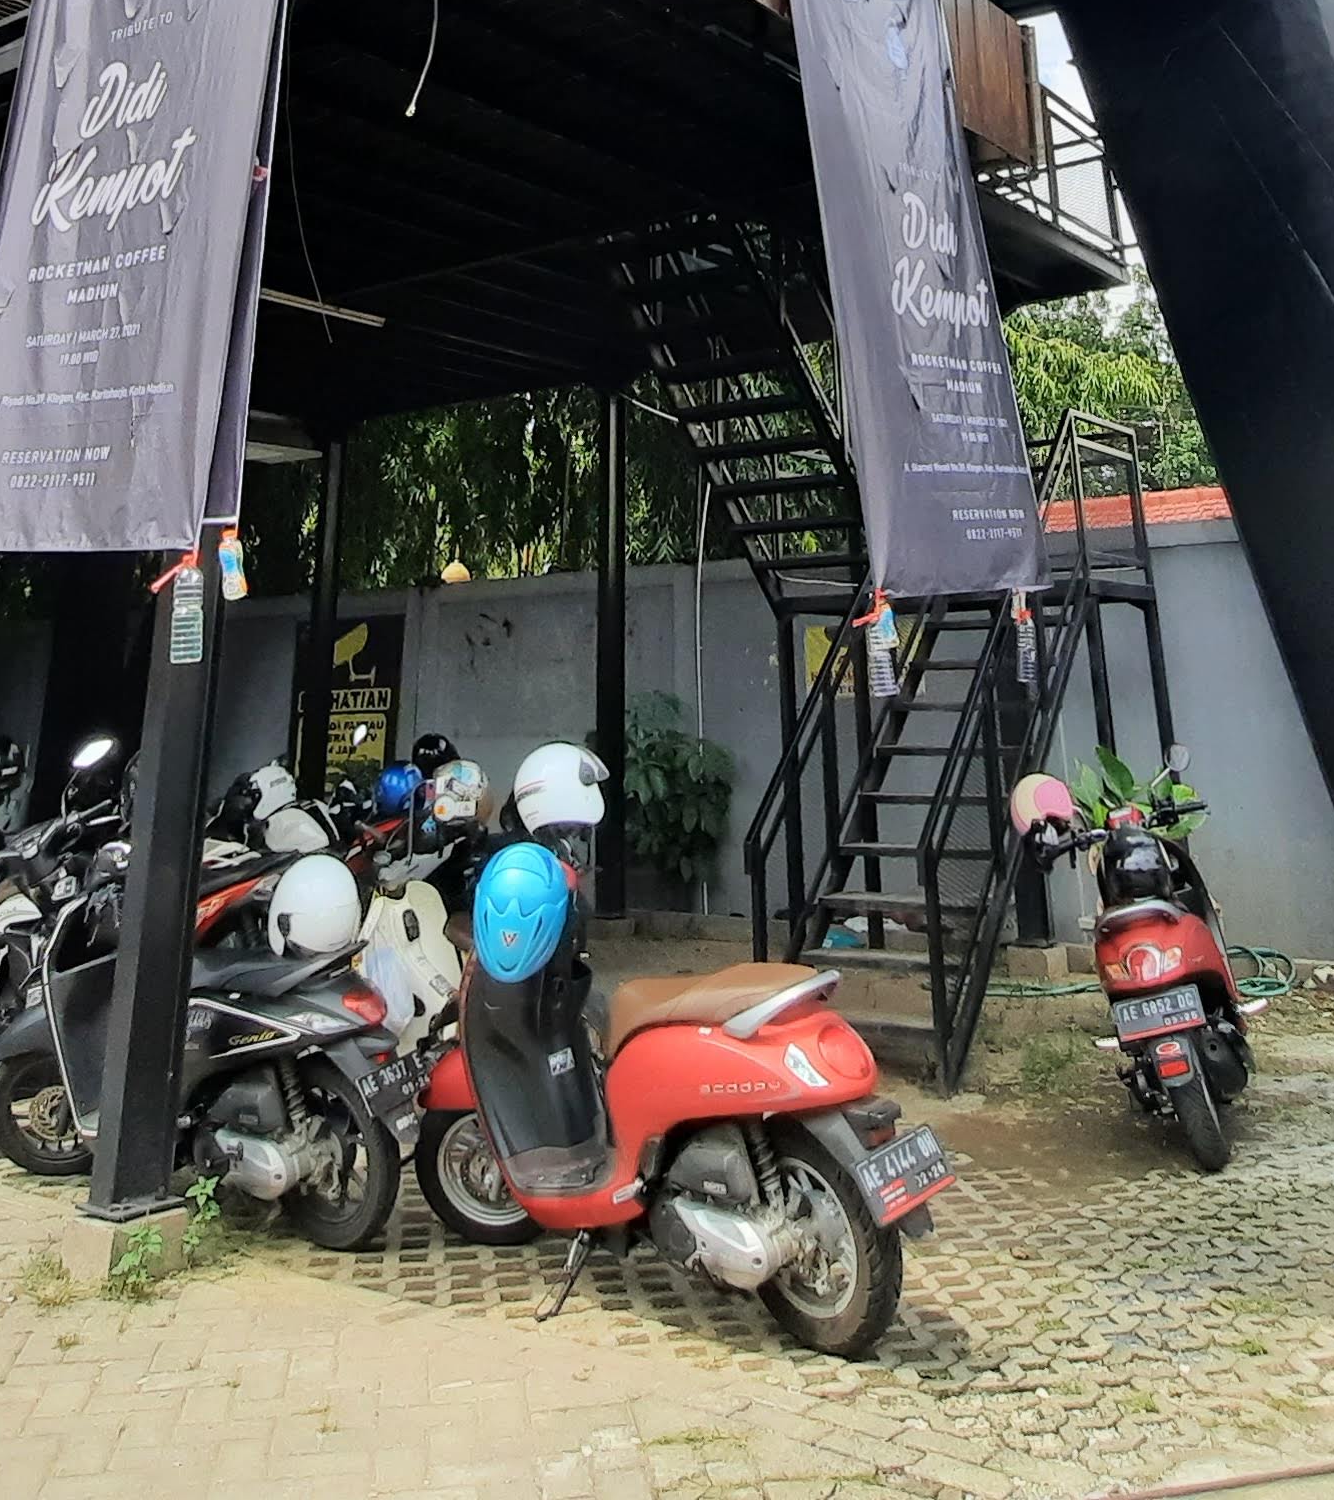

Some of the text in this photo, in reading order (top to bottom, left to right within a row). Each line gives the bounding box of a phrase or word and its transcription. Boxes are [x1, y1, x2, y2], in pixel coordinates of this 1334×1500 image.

[110, 11, 173, 43] TRIBUTE TO
[79, 60, 167, 139] Didi
[30, 125, 197, 233] Kempot
[902, 191, 959, 257] Didi
[27, 244, 168, 284] ROCKETMAN COFFEE
[67, 283, 119, 305] MADIUN
[891, 255, 990, 339] Kempot
[25, 333, 72, 349] SATURDAY
[1, 446, 111, 465] RESERVATION NOW
[8, 472, 97, 489] 0822-2117-9511
[952, 508, 1007, 521] RESERVATION
[330, 690, 388, 710] HATIAN
[1121, 1005, 1139, 1024] AE
[226, 1029, 275, 1047] Genio
[361, 1073, 380, 1096] AE
[862, 1162, 884, 1192] AE
[884, 1142, 918, 1178] 4144
